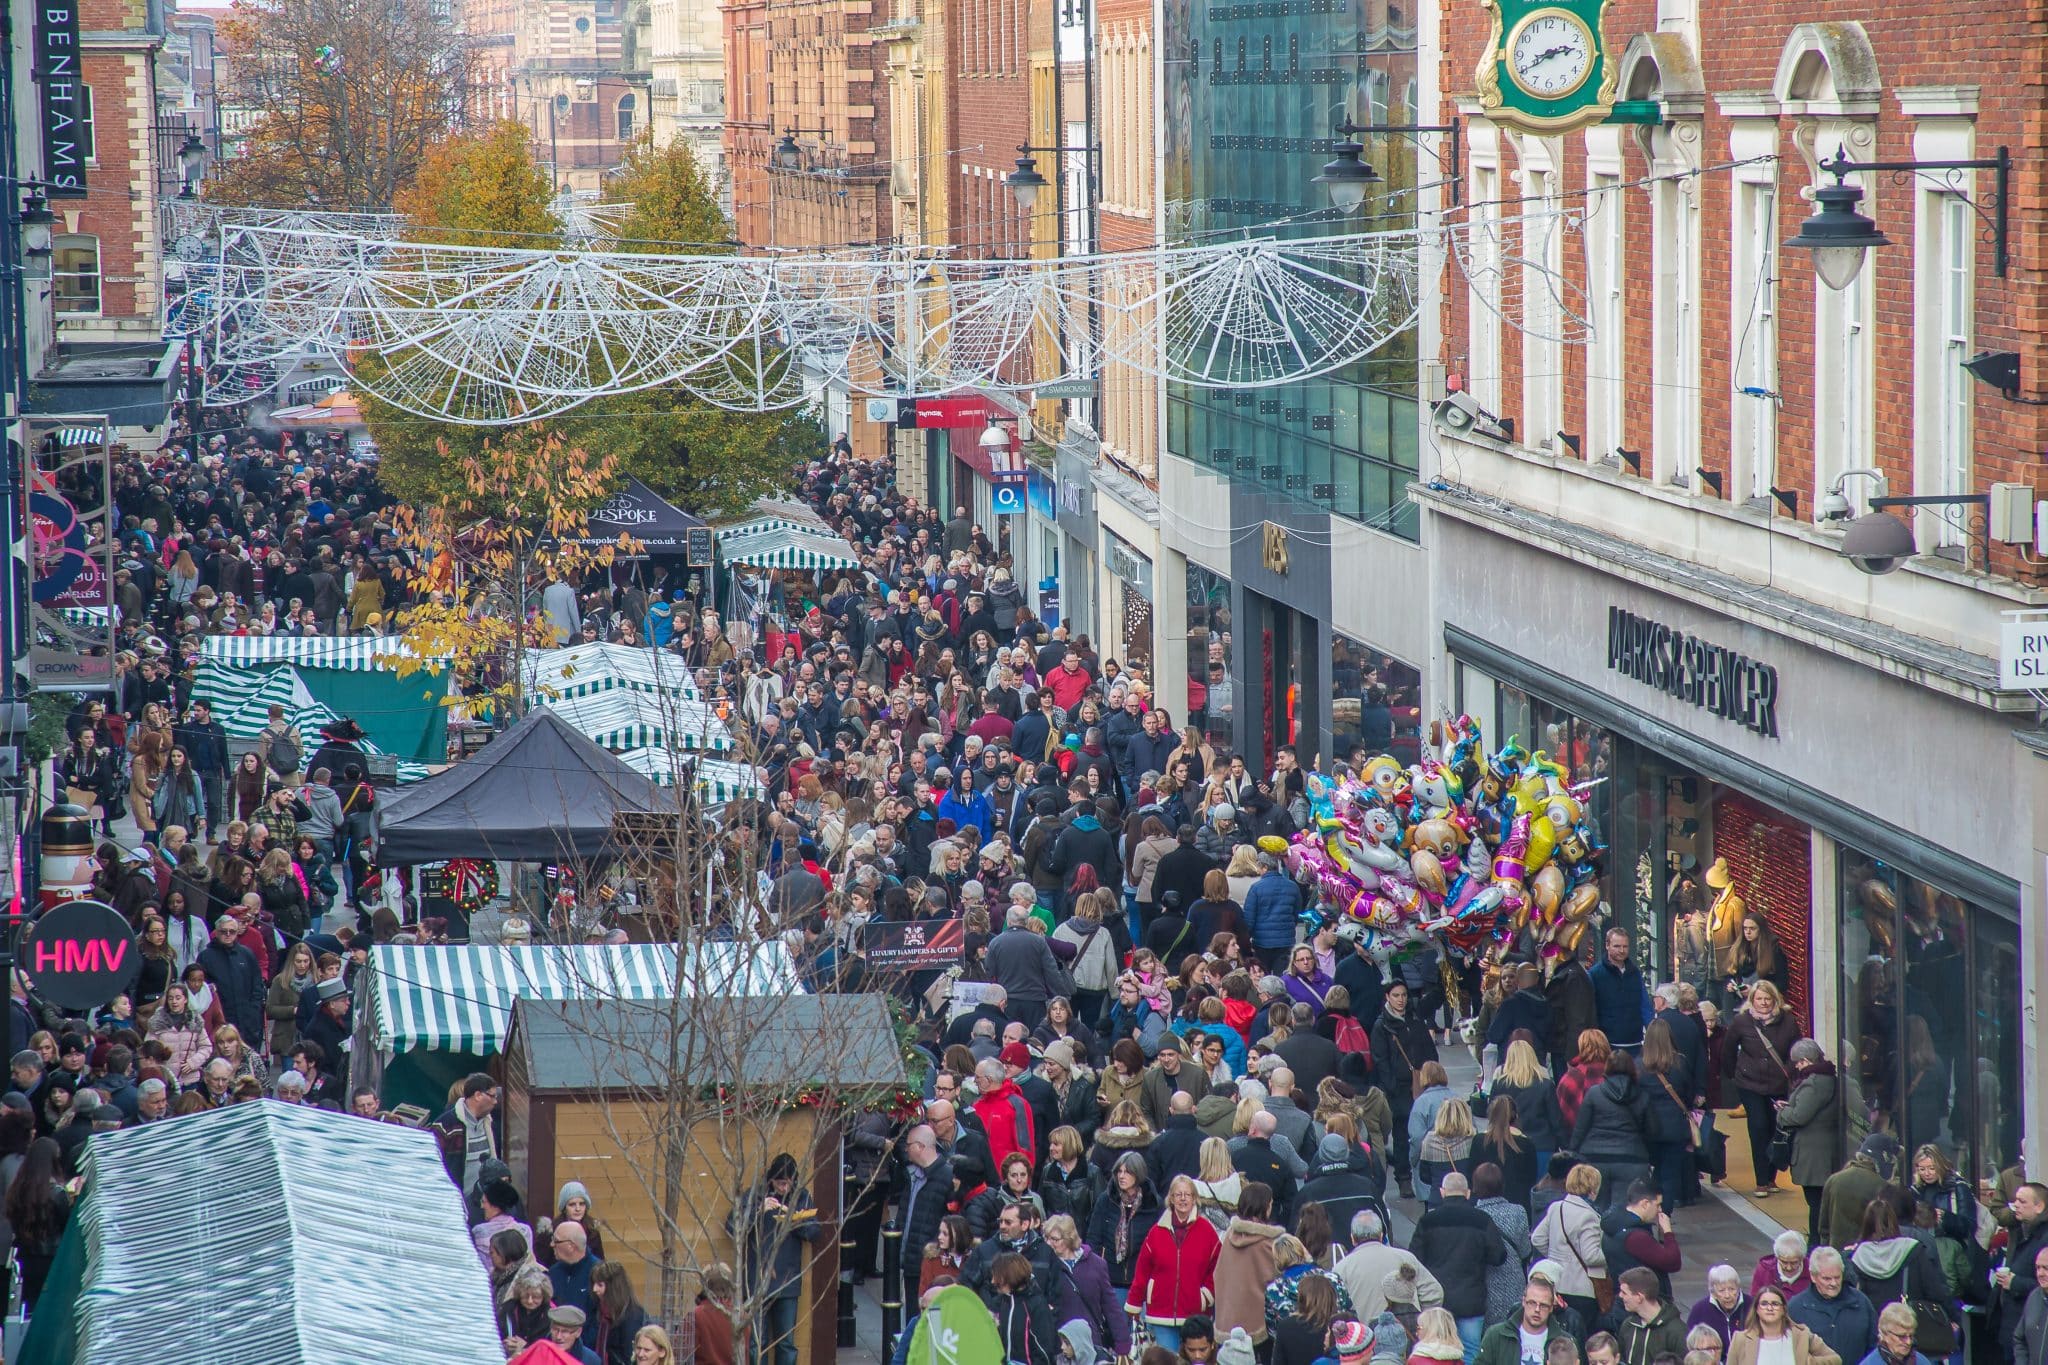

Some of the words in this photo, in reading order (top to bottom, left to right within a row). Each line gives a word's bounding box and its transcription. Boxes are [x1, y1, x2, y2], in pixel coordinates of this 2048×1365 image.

[1532, 24, 1539, 33] 11
[1545, 20, 1554, 29] 12
[1522, 35, 1531, 43] 10
[1573, 34, 1579, 43] 2
[1516, 50, 1524, 60] 9
[1572, 65, 1577, 75] 4
[1533, 76, 1539, 85] 7
[1545, 79, 1552, 88] 6
[1560, 75, 1567, 85] 5
[46, 9, 77, 189] BENHAMS
[1048, 385, 1091, 394] SWAROVSKI
[2015, 658, 2048, 676] ISL
[35, 938, 128, 973] HMV
